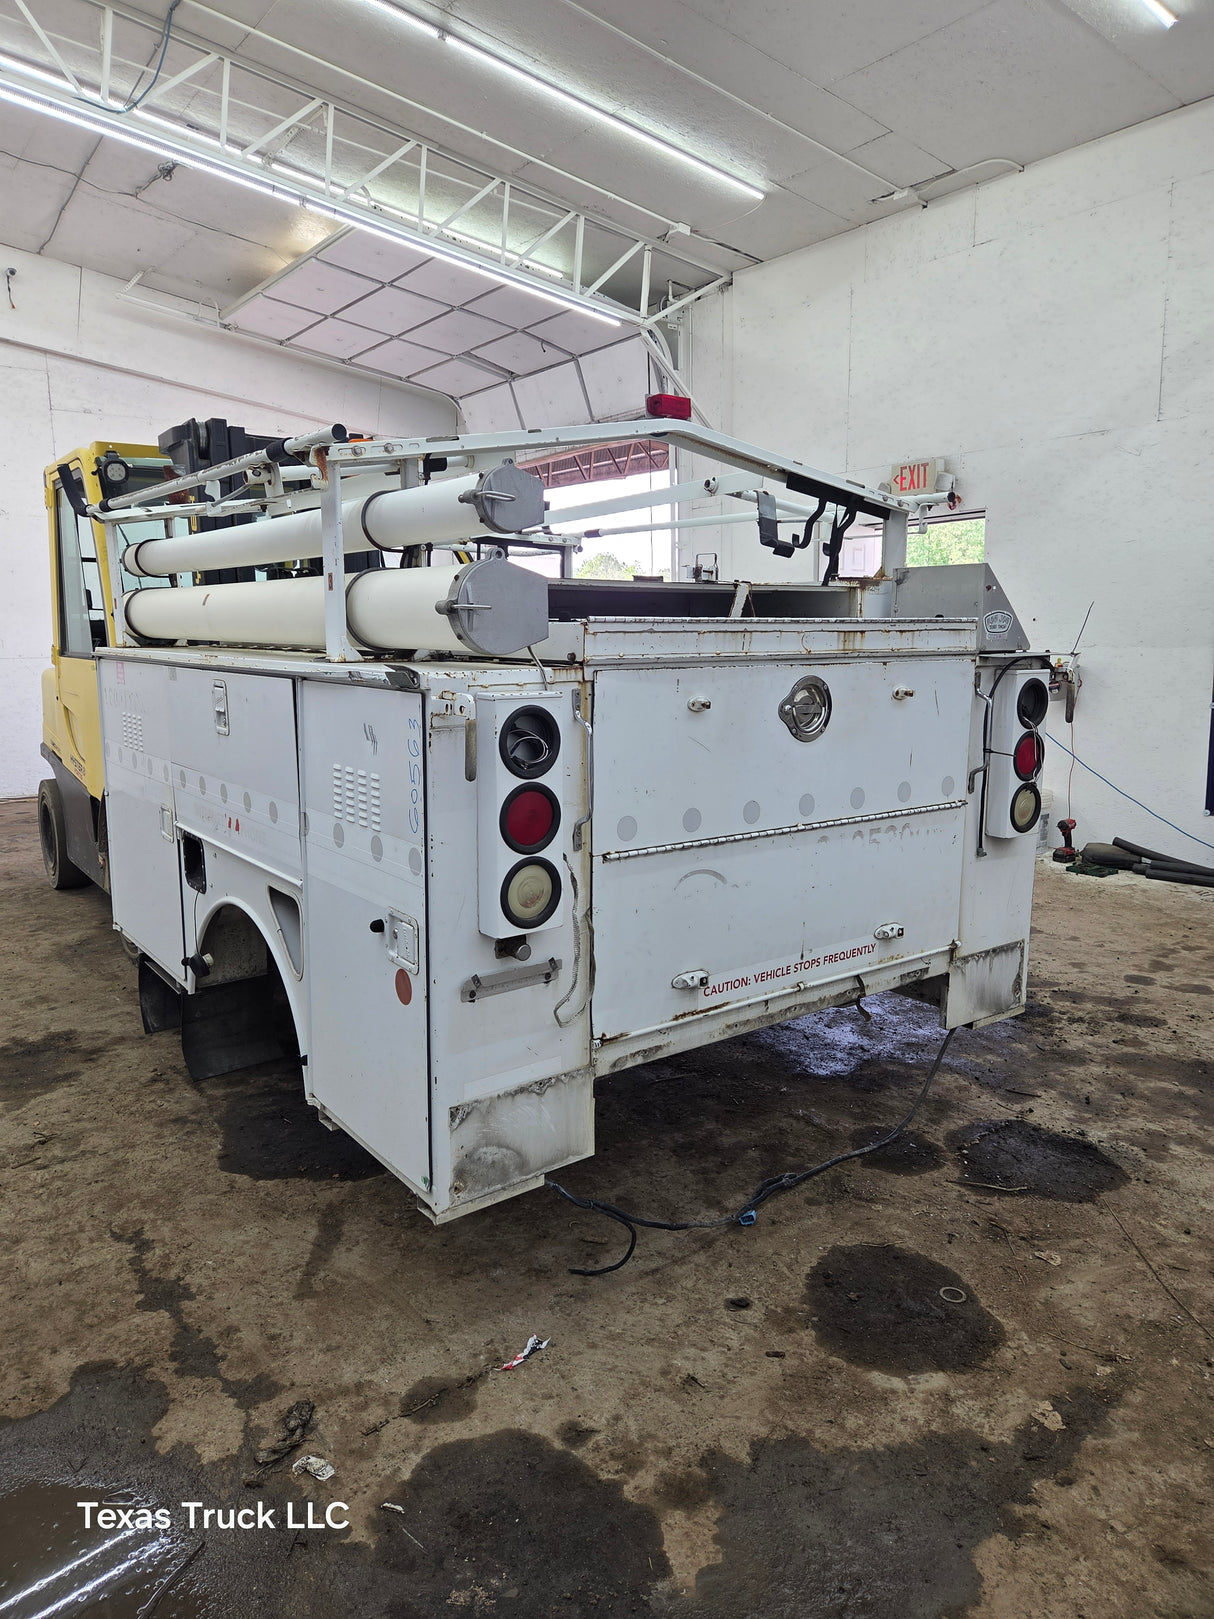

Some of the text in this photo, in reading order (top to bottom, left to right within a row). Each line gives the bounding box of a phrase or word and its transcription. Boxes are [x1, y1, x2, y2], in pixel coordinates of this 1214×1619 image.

[899, 462, 929, 492] EXIT
[703, 942, 877, 998] CAUTION: VEHICLE STOPS FREQUENTLY
